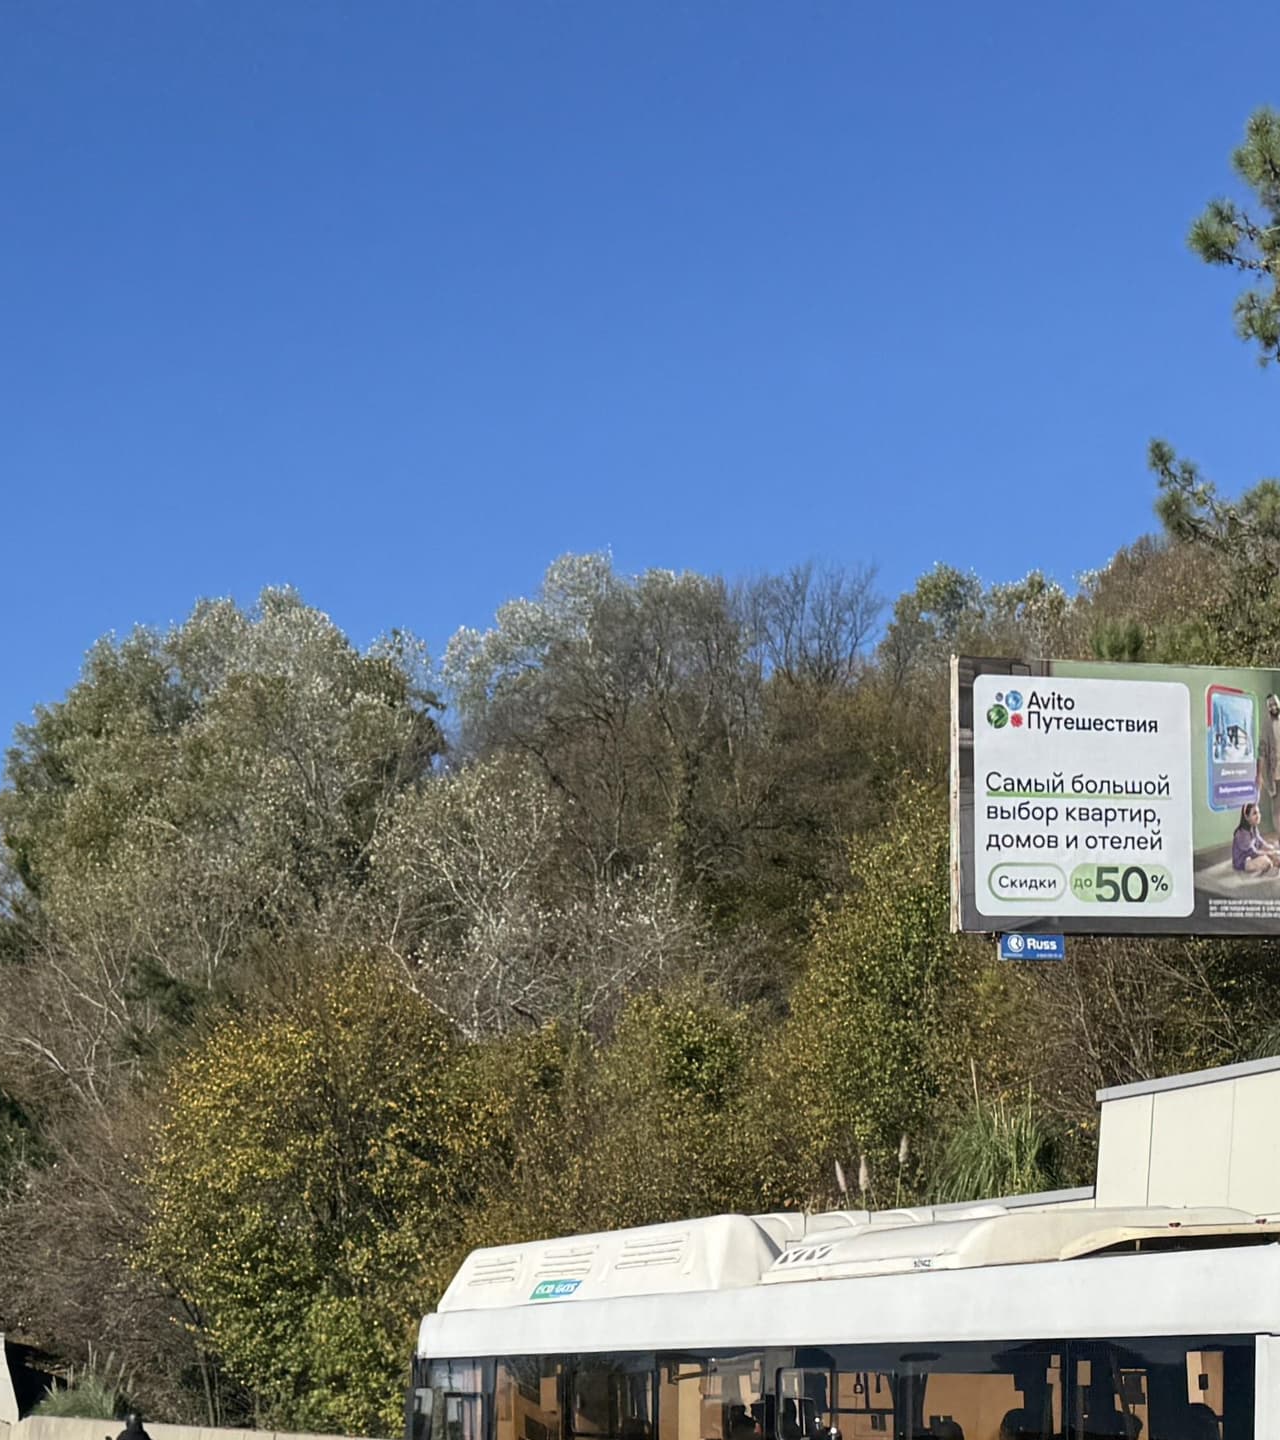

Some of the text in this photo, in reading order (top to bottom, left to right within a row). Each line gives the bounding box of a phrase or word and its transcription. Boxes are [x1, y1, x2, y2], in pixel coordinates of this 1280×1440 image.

[1027, 690, 1075, 711] Avito
[1027, 711, 1158, 734] Путешествия
[986, 771, 1170, 795] Самый большой
[987, 801, 1161, 828] выбор квартир,
[986, 830, 1163, 851] домов и отелей
[998, 875, 1057, 889] Скидки
[1074, 877, 1093, 890] до
[1026, 938, 1057, 950] Russ
